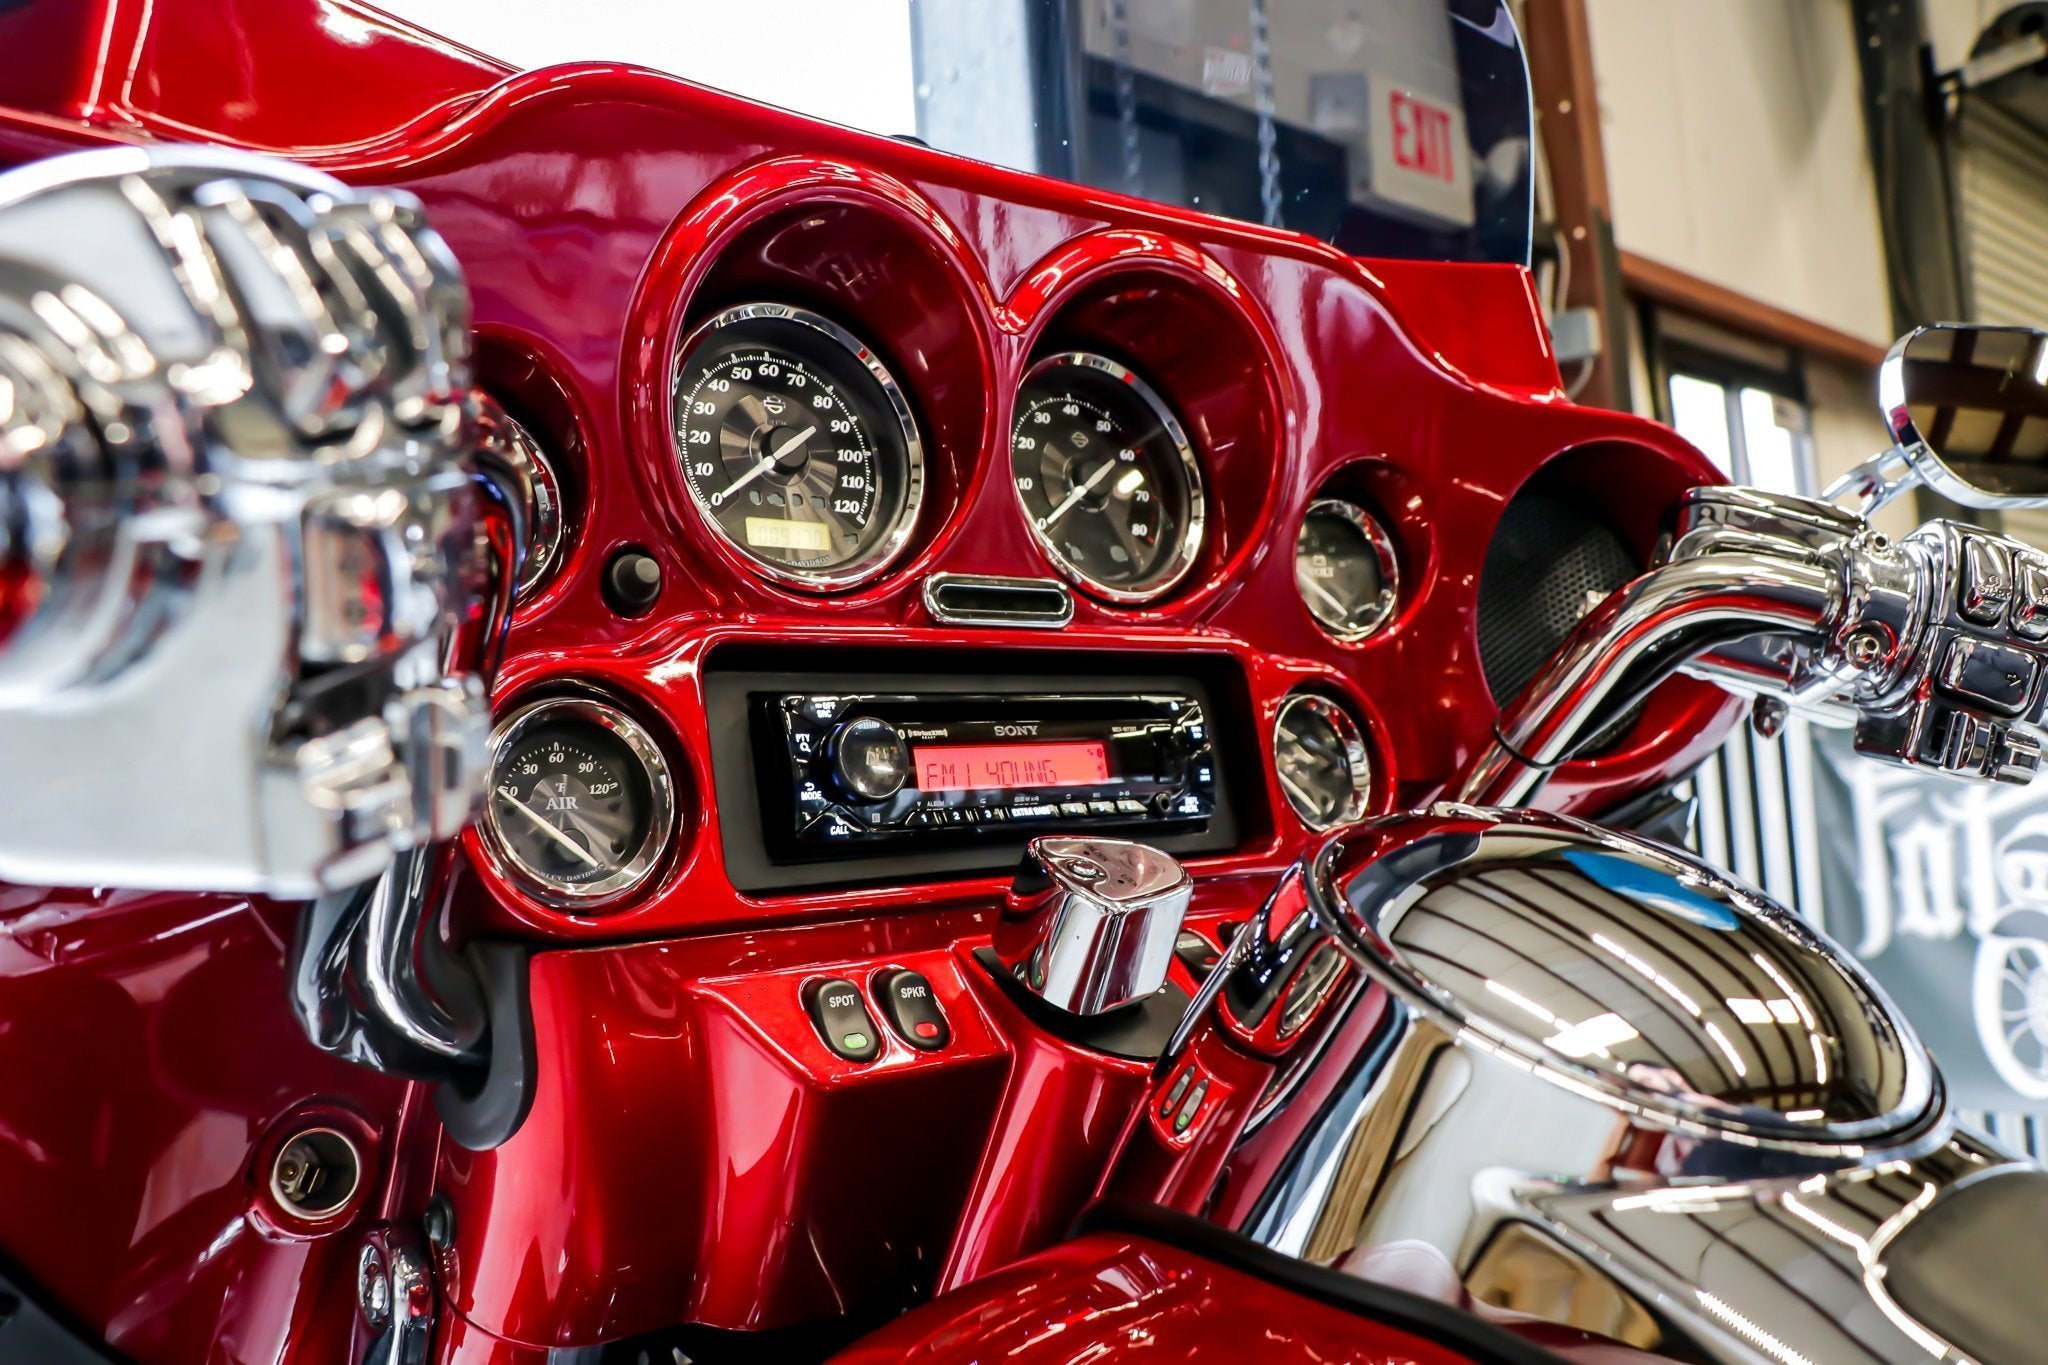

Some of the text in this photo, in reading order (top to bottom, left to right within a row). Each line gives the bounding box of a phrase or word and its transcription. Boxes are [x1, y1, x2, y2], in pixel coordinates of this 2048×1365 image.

[1390, 91, 1455, 184] EXIT
[730, 366, 752, 381] 50
[758, 363, 780, 377] 60
[707, 379, 730, 393] 40
[786, 372, 807, 388] 70
[693, 401, 716, 416] 30
[812, 395, 833, 410] 80
[1062, 403, 1080, 416] 40
[1033, 411, 1051, 425] 30
[830, 419, 851, 434] 90
[1096, 420, 1112, 433] 50
[688, 429, 711, 445] 20
[1017, 437, 1036, 450] 20
[837, 448, 863, 464] 100
[1119, 449, 1135, 462] 60
[694, 461, 714, 477] 10
[841, 474, 865, 490] 110
[1016, 477, 1033, 491] 10
[710, 492, 723, 507] 0
[1135, 490, 1150, 503] 70
[834, 498, 860, 514] 120
[1131, 524, 1148, 537] 80
[795, 733, 811, 743] PTY
[993, 725, 1038, 737] SONY
[548, 752, 565, 764] 60
[522, 763, 539, 776] 30
[578, 762, 594, 774] 90
[589, 783, 610, 796] 120
[801, 790, 822, 801] MODE
[545, 796, 580, 811] AIR
[830, 825, 849, 836] CALL
[900, 985, 927, 999] SPKR
[828, 994, 855, 1008] SPOT
